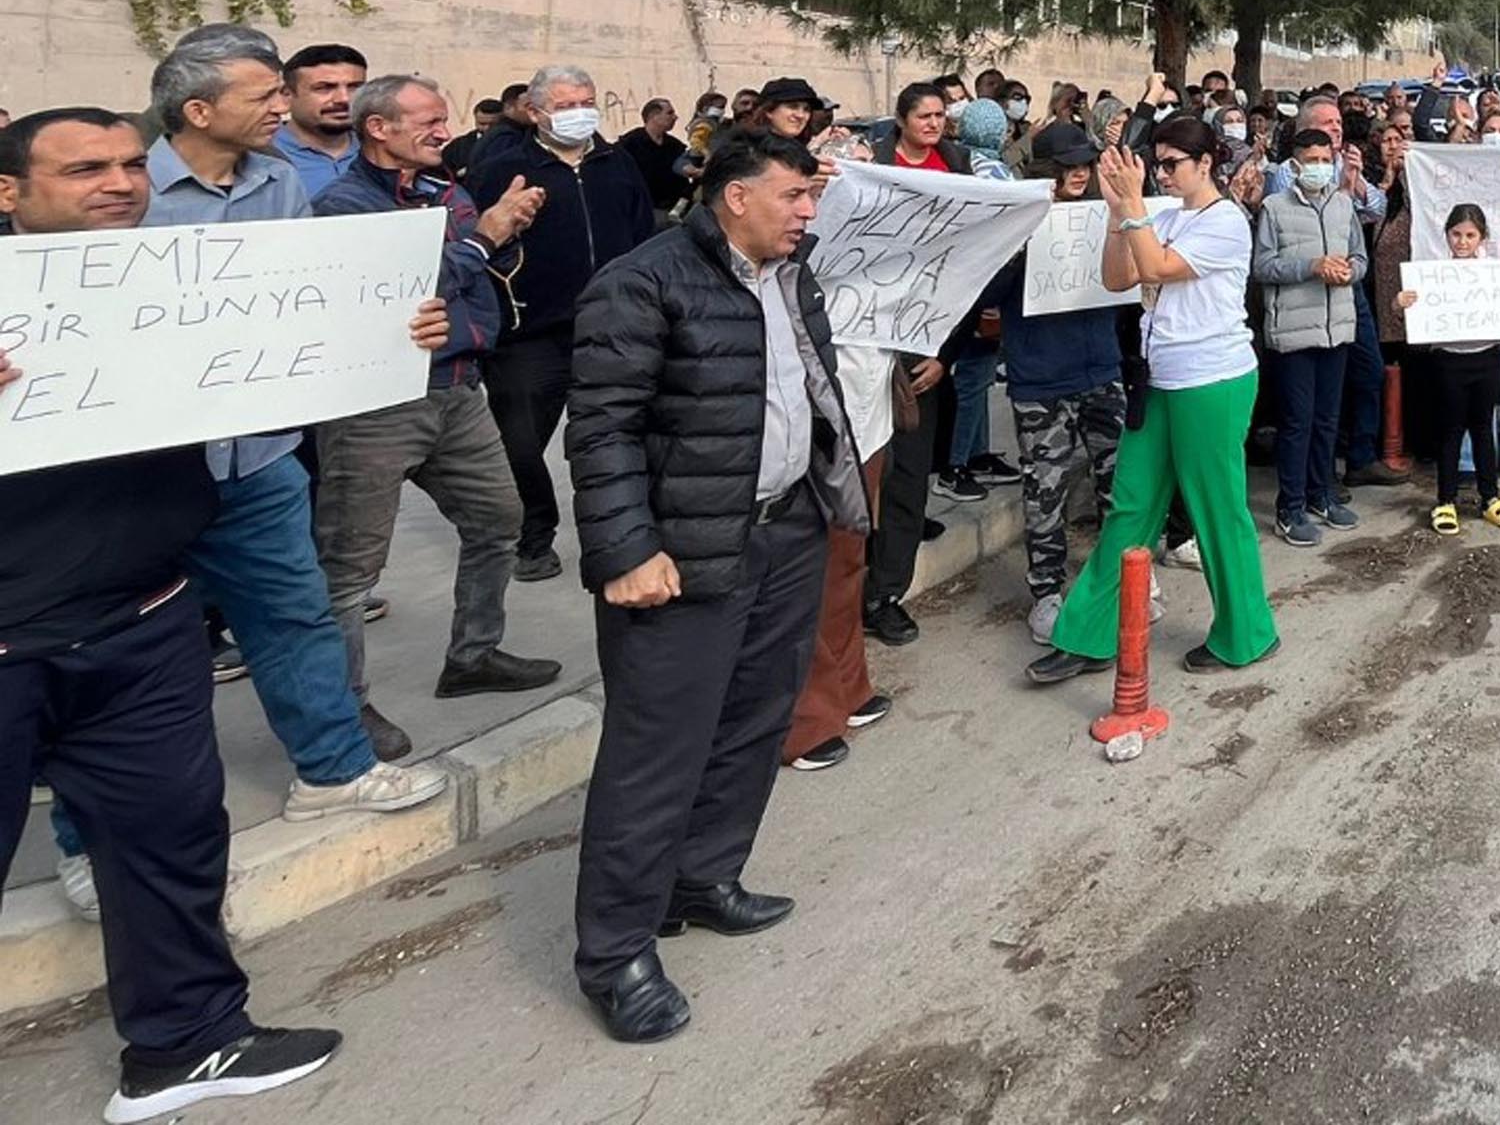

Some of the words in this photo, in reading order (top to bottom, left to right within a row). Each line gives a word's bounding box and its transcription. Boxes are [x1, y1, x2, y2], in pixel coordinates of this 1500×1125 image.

[1050, 239, 1099, 262] ÇEV
[0, 302, 88, 353] BİR
[131, 285, 327, 331] DÜNYA
[358, 273, 432, 306] İÇİN
[12, 368, 116, 421] EL
